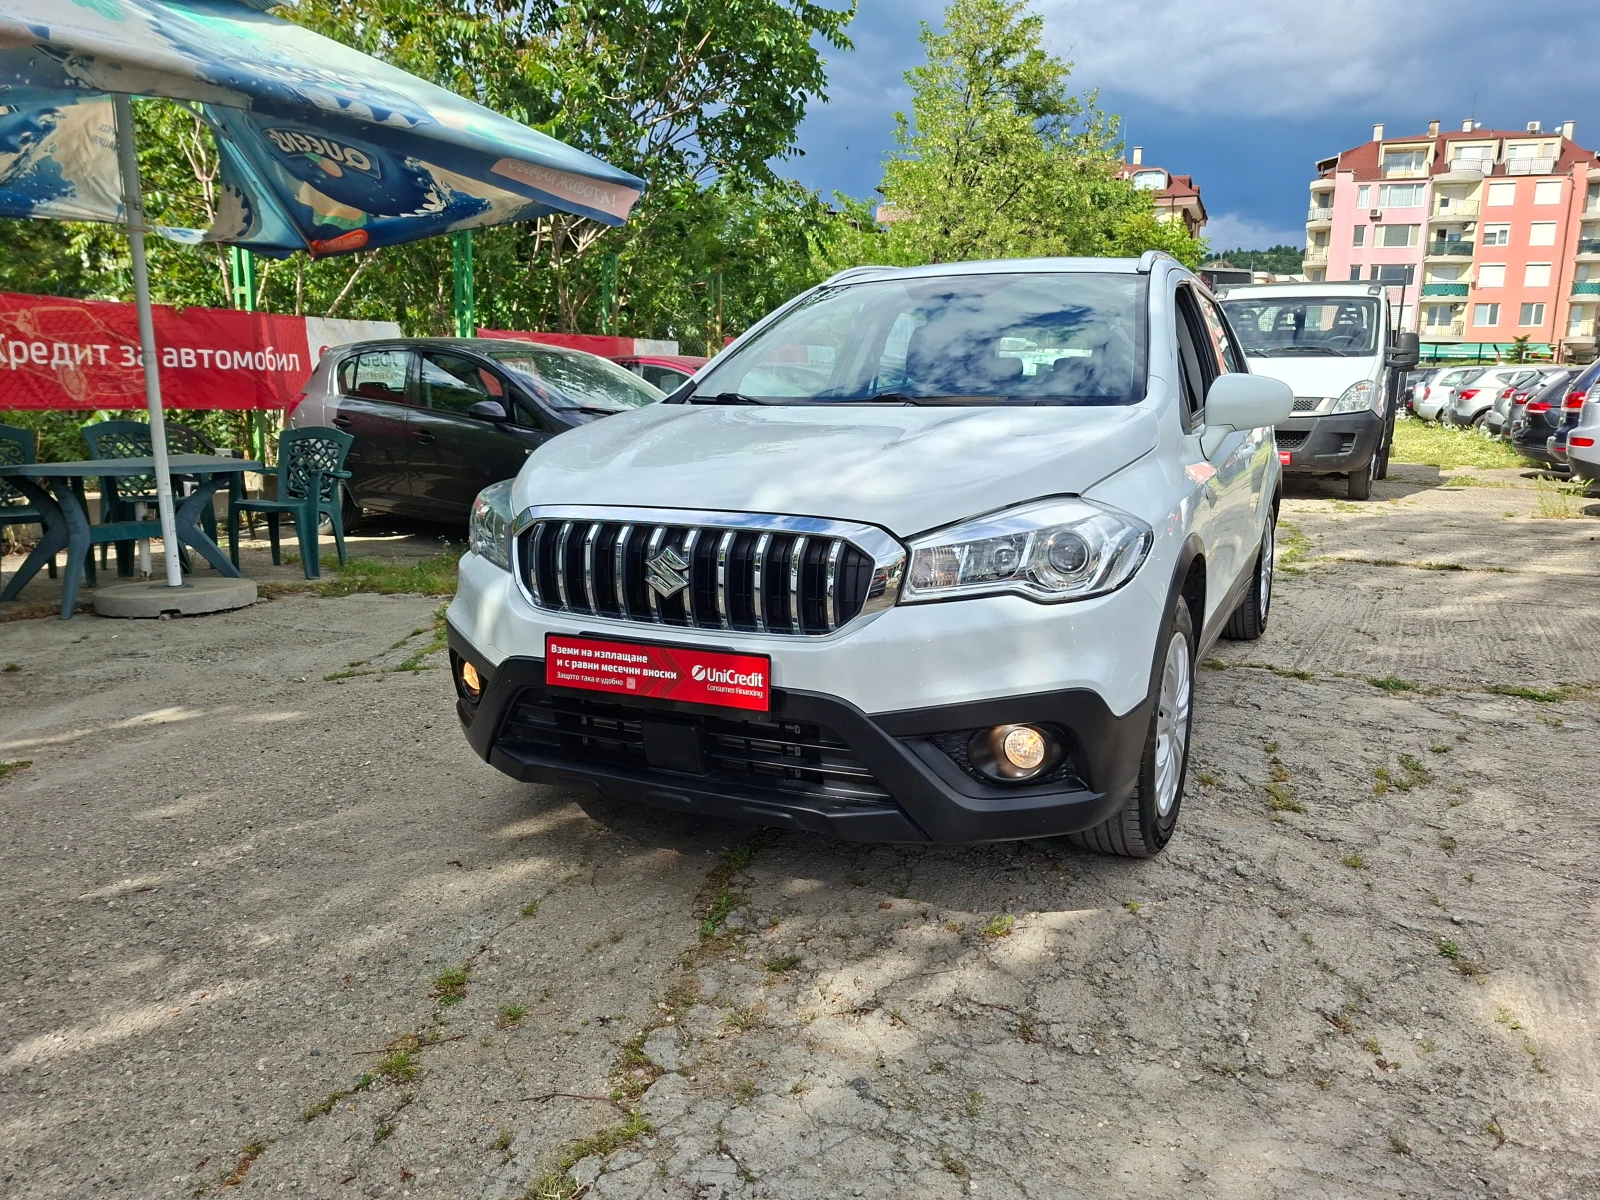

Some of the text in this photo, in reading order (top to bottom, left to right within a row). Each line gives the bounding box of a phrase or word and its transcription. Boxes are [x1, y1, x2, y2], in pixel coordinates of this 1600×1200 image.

[163, 345, 301, 372] автомобил
[551, 644, 648, 663] Вземи на изплащане
[556, 671, 579, 680] Защото
[581, 675, 594, 683] така
[601, 677, 623, 686] удобно
[572, 661, 599, 670] равни
[601, 664, 640, 675] месечни
[643, 669, 677, 679] вноски
[707, 667, 763, 688] UniCredit
[707, 684, 763, 698] Consumer Financing
